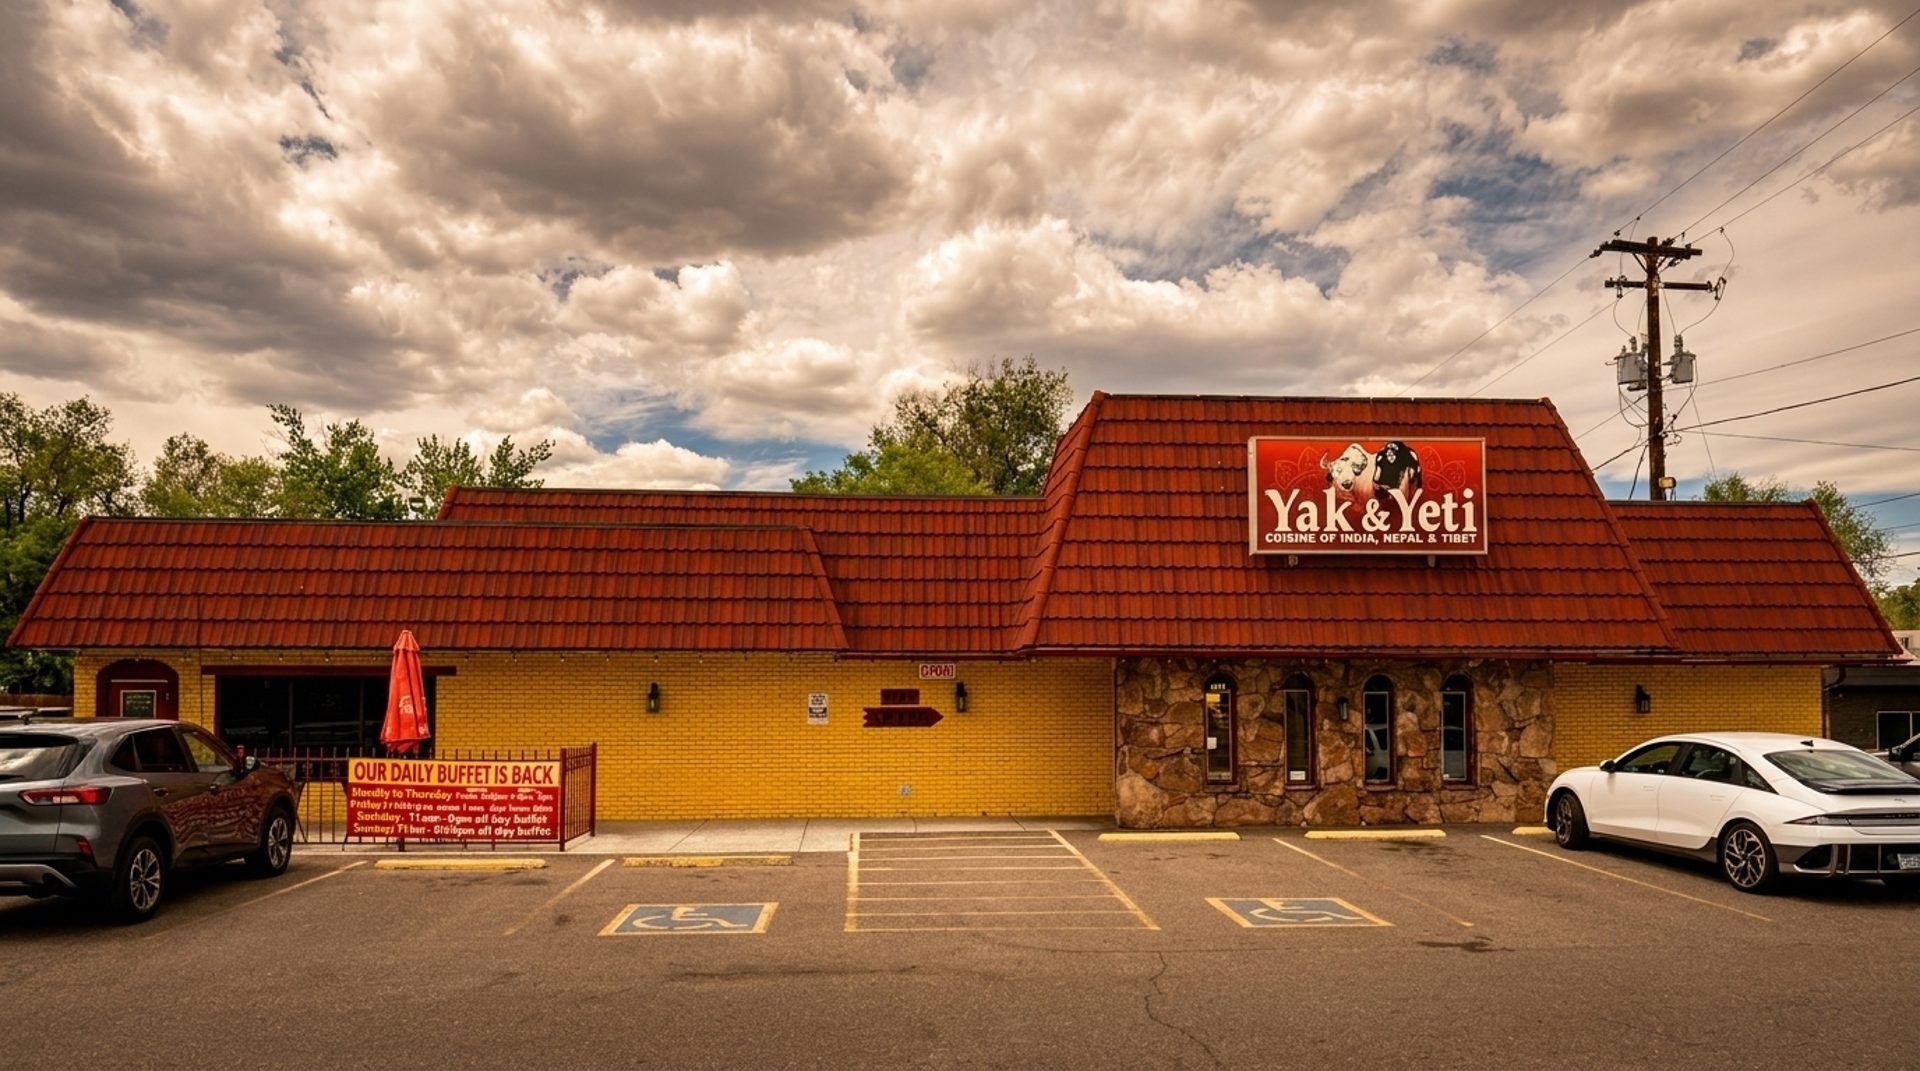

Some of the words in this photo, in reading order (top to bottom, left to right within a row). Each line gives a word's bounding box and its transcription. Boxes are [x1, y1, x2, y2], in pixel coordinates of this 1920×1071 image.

[1265, 488, 1354, 532] Yak
[1362, 498, 1391, 532] &
[1388, 488, 1477, 532] Yeti
[1320, 533, 1336, 543] OF
[1340, 533, 1379, 545] INDIA,
[1383, 533, 1423, 543] NEPAL
[1427, 533, 1437, 543] &
[1441, 533, 1477, 543] TIBET
[354, 762, 387, 781] OUR
[391, 763, 434, 783] DAILY
[437, 764, 491, 784] BUFFET
[494, 765, 508, 784] IS
[512, 765, 553, 784] BACK
